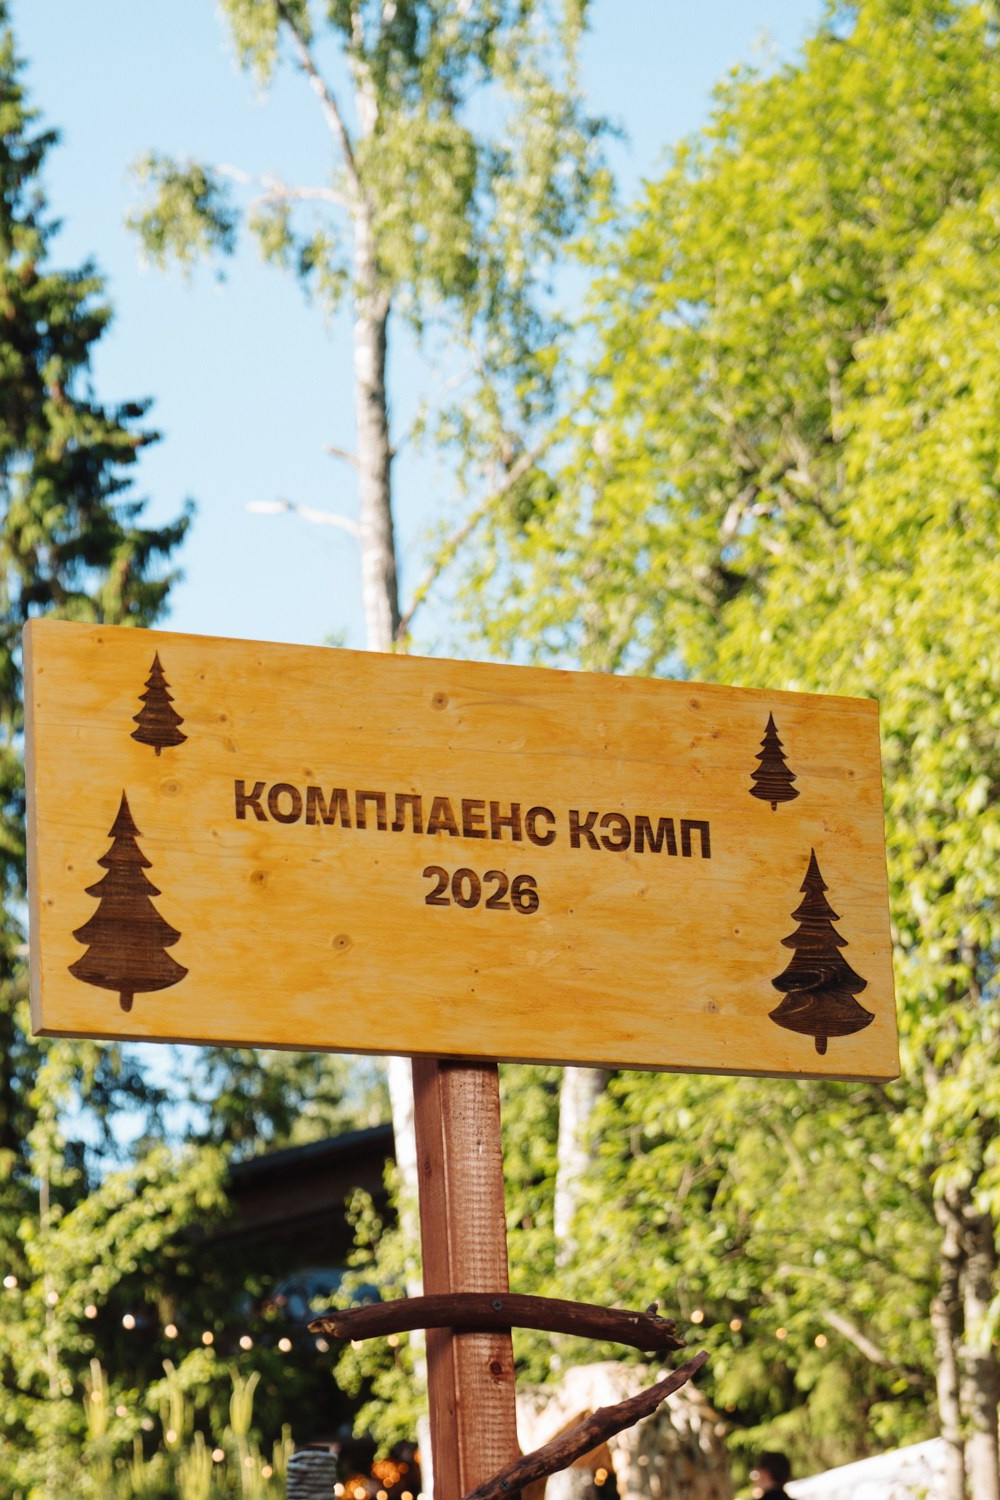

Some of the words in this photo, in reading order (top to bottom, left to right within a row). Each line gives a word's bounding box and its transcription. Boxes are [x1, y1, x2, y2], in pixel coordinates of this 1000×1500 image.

[234, 779, 557, 847] КОМПЛАЕНС
[568, 809, 712, 859] КЭМП
[422, 865, 540, 915] 2026
